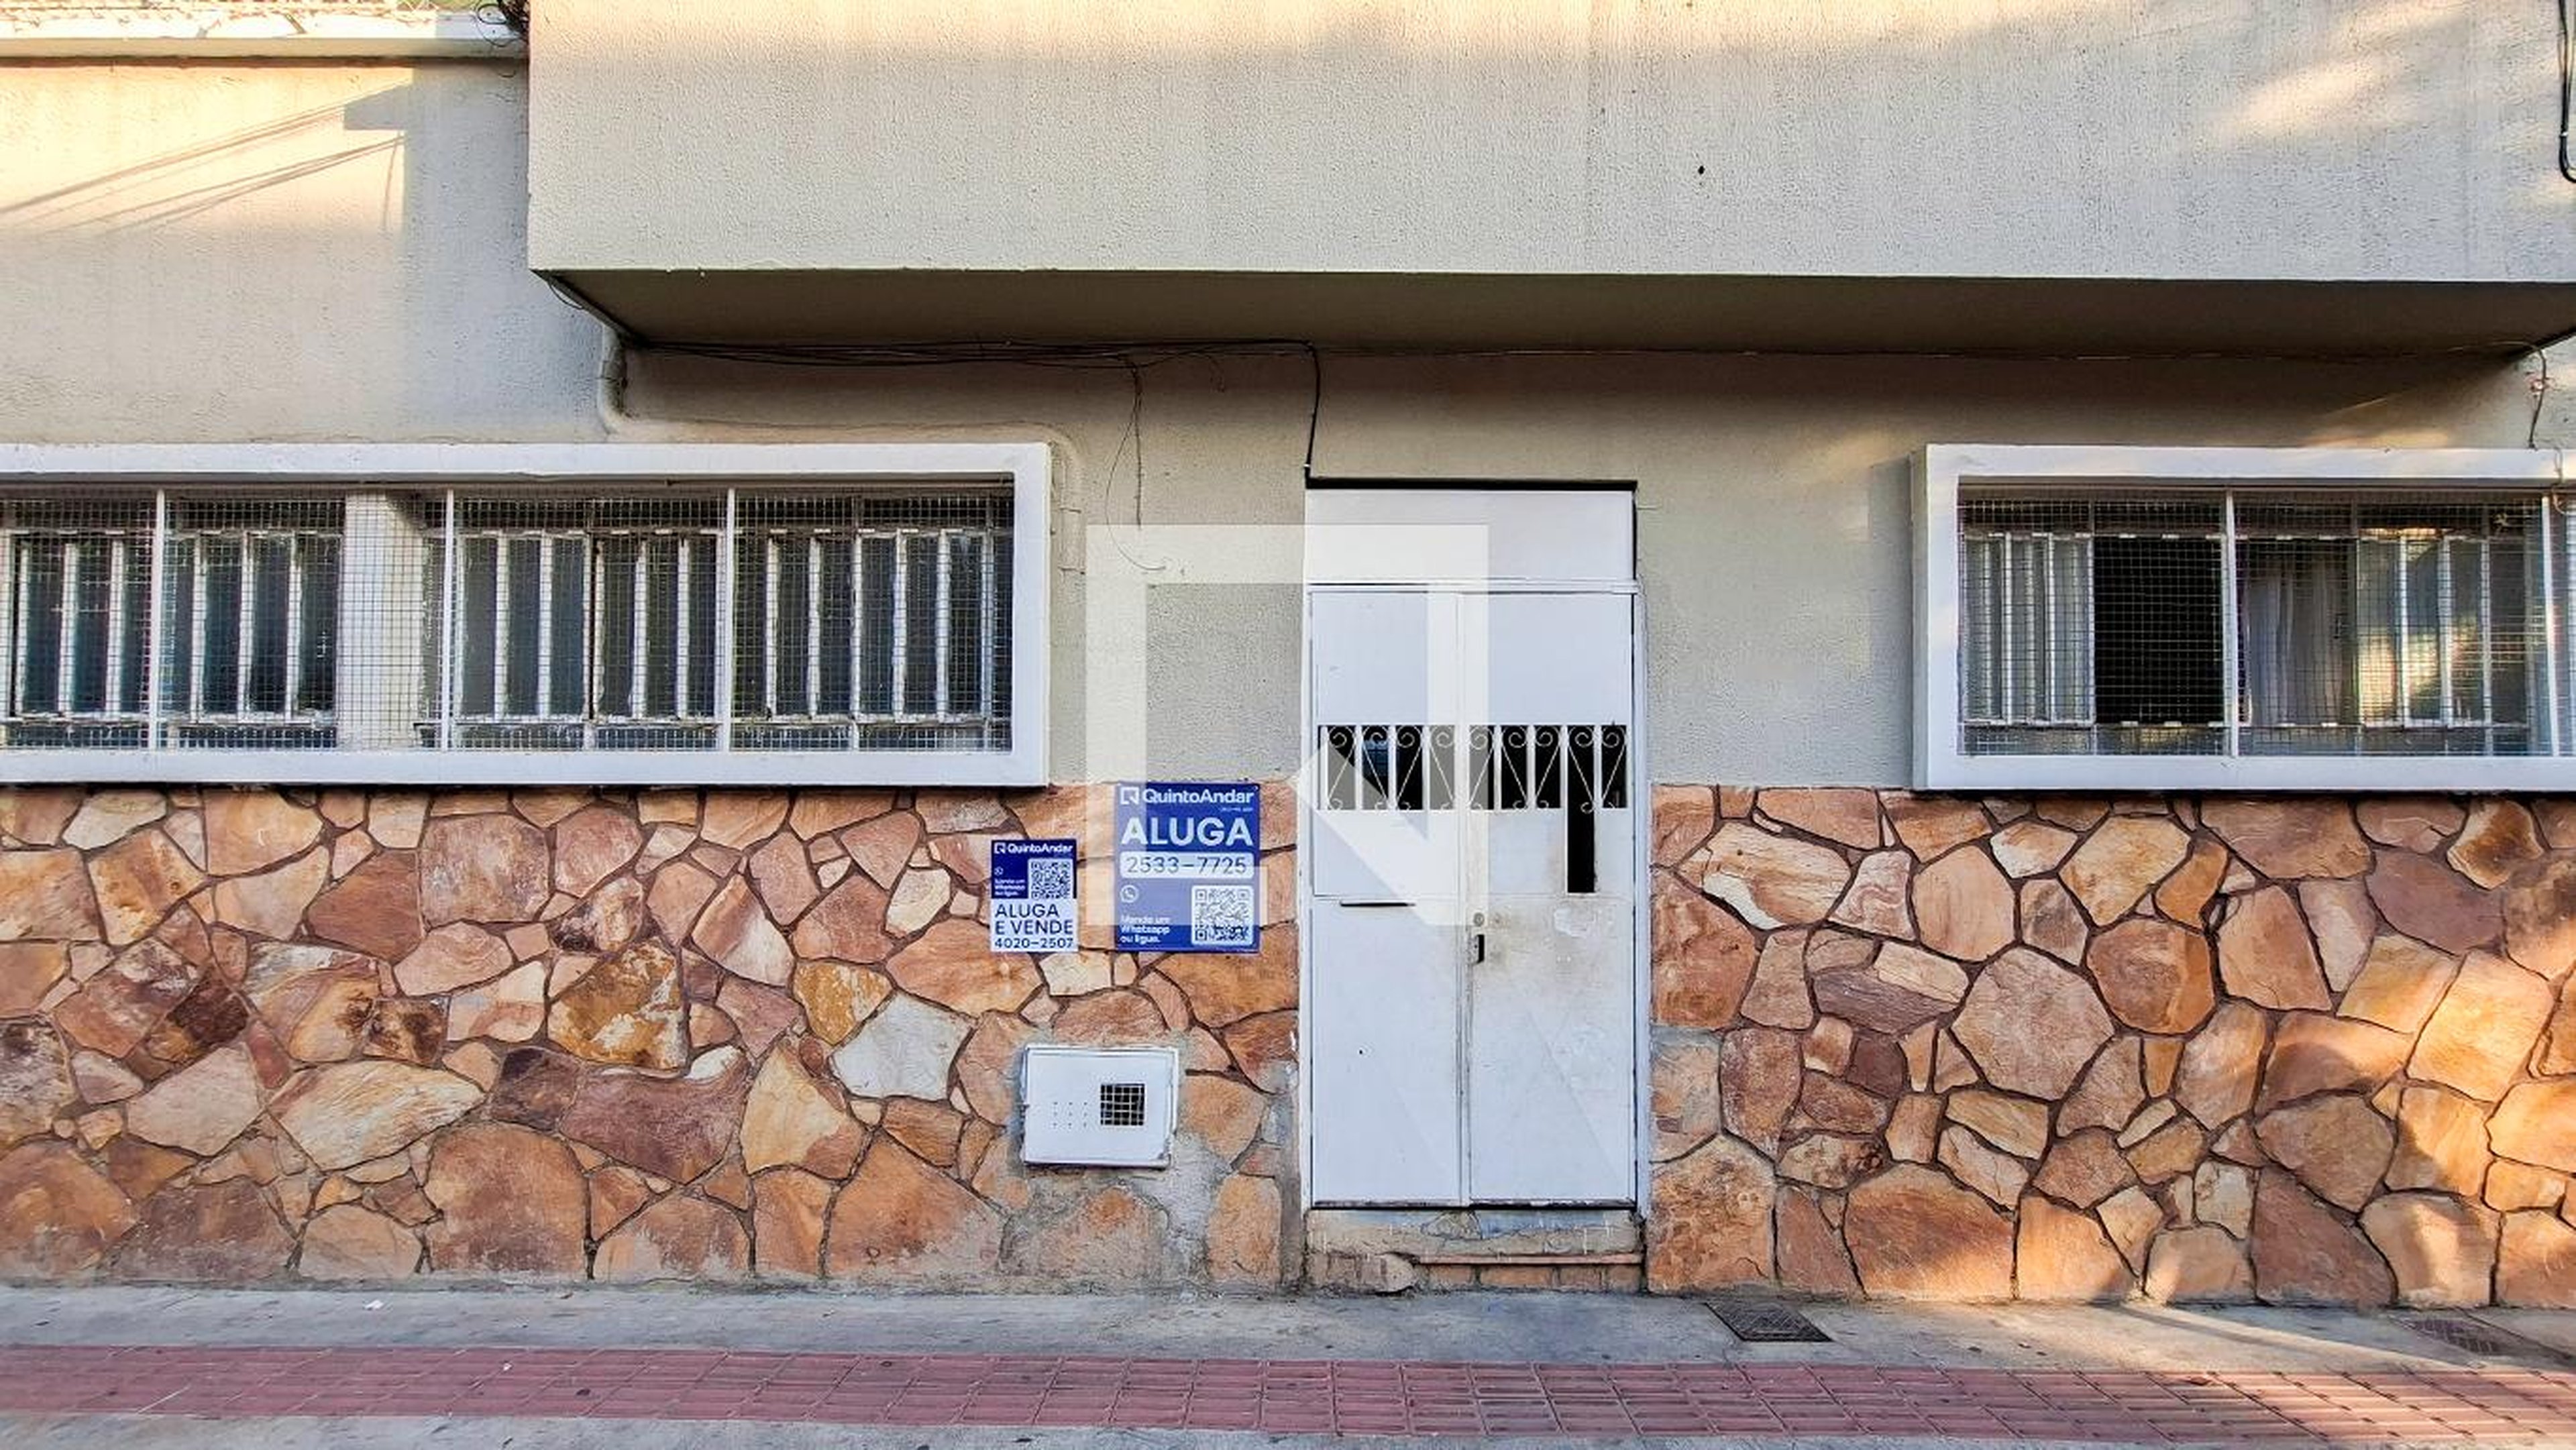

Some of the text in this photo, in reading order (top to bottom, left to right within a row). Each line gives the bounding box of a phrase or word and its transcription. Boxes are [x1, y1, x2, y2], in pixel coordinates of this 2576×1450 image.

[1143, 788, 1254, 803] QuintoAndar
[1121, 817, 1253, 846] ALUGA
[1008, 843, 1073, 854] QuintoAndar
[1126, 856, 1247, 873] 2533-7725
[995, 903, 1059, 918] ALUGA
[996, 919, 1073, 935] E VENDE
[995, 938, 1073, 949] 4020-2507
